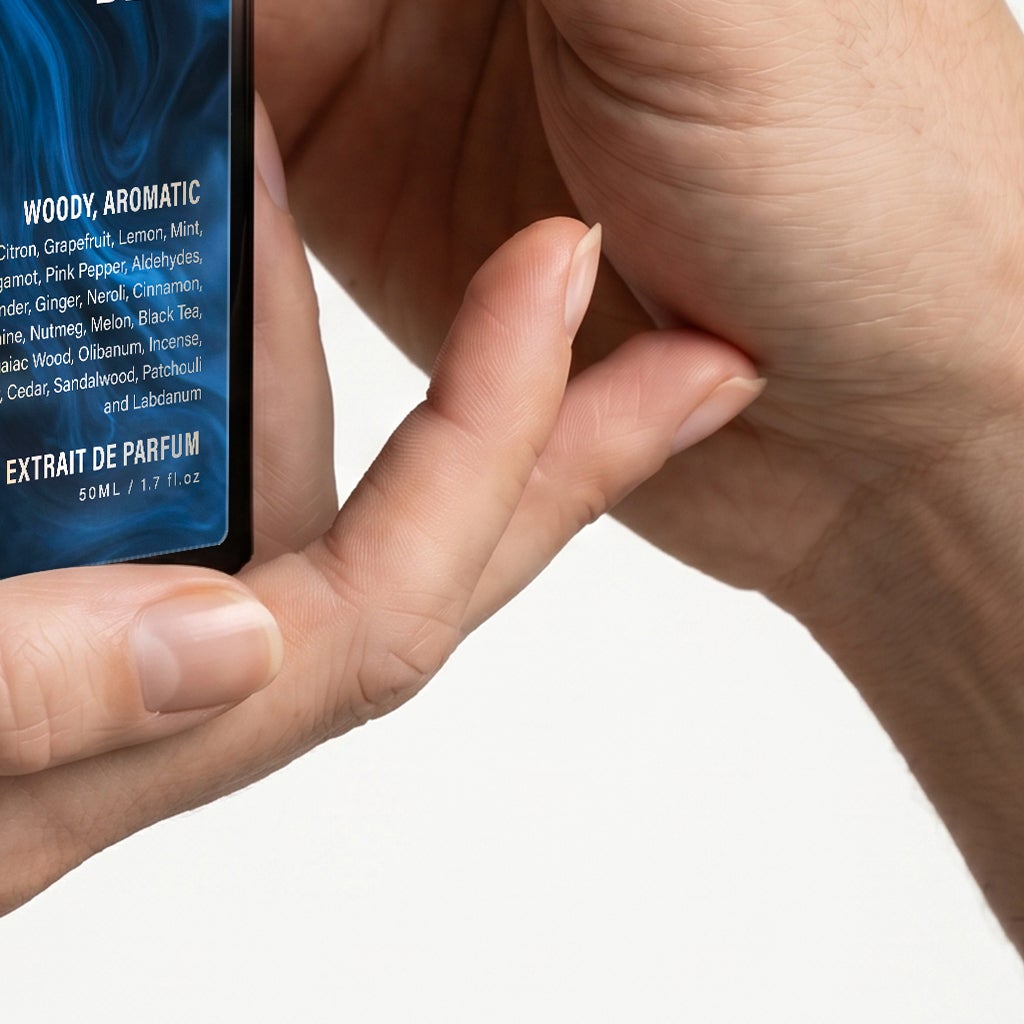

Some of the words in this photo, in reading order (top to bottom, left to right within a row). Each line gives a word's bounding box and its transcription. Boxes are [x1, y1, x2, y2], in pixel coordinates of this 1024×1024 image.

[23, 192, 98, 226] WOODY,
[103, 179, 201, 216] AROMATIC
[44, 232, 115, 256] Grapefruit,
[118, 226, 167, 245] Lemon,
[170, 220, 203, 239] Mint,
[45, 263, 75, 284] Pink
[78, 259, 128, 282] Pepper,
[131, 249, 203, 272] Aldehydes,
[35, 294, 83, 314] Ginger,
[87, 284, 129, 305] Neroli,
[133, 278, 203, 299] Cinnamon,
[30, 320, 87, 342] Nutmeg,
[91, 313, 134, 333] Melon,
[138, 306, 174, 326] Black
[177, 304, 202, 321] Tea,
[32, 348, 74, 369] Wood,
[78, 340, 145, 362] Olibanum,
[149, 332, 203, 352] Incense,
[7, 381, 50, 401] Cedar,
[53, 366, 139, 393] Sandalwood,
[143, 356, 202, 381] Patchouli
[103, 394, 129, 414] and
[133, 386, 202, 410] Labdanum
[6, 448, 87, 485] EXTRAIT
[92, 443, 117, 471] DE
[123, 430, 200, 467] PARFUM
[78, 483, 121, 502] 50ML
[127, 479, 134, 495] /
[140, 476, 160, 492] 1.7
